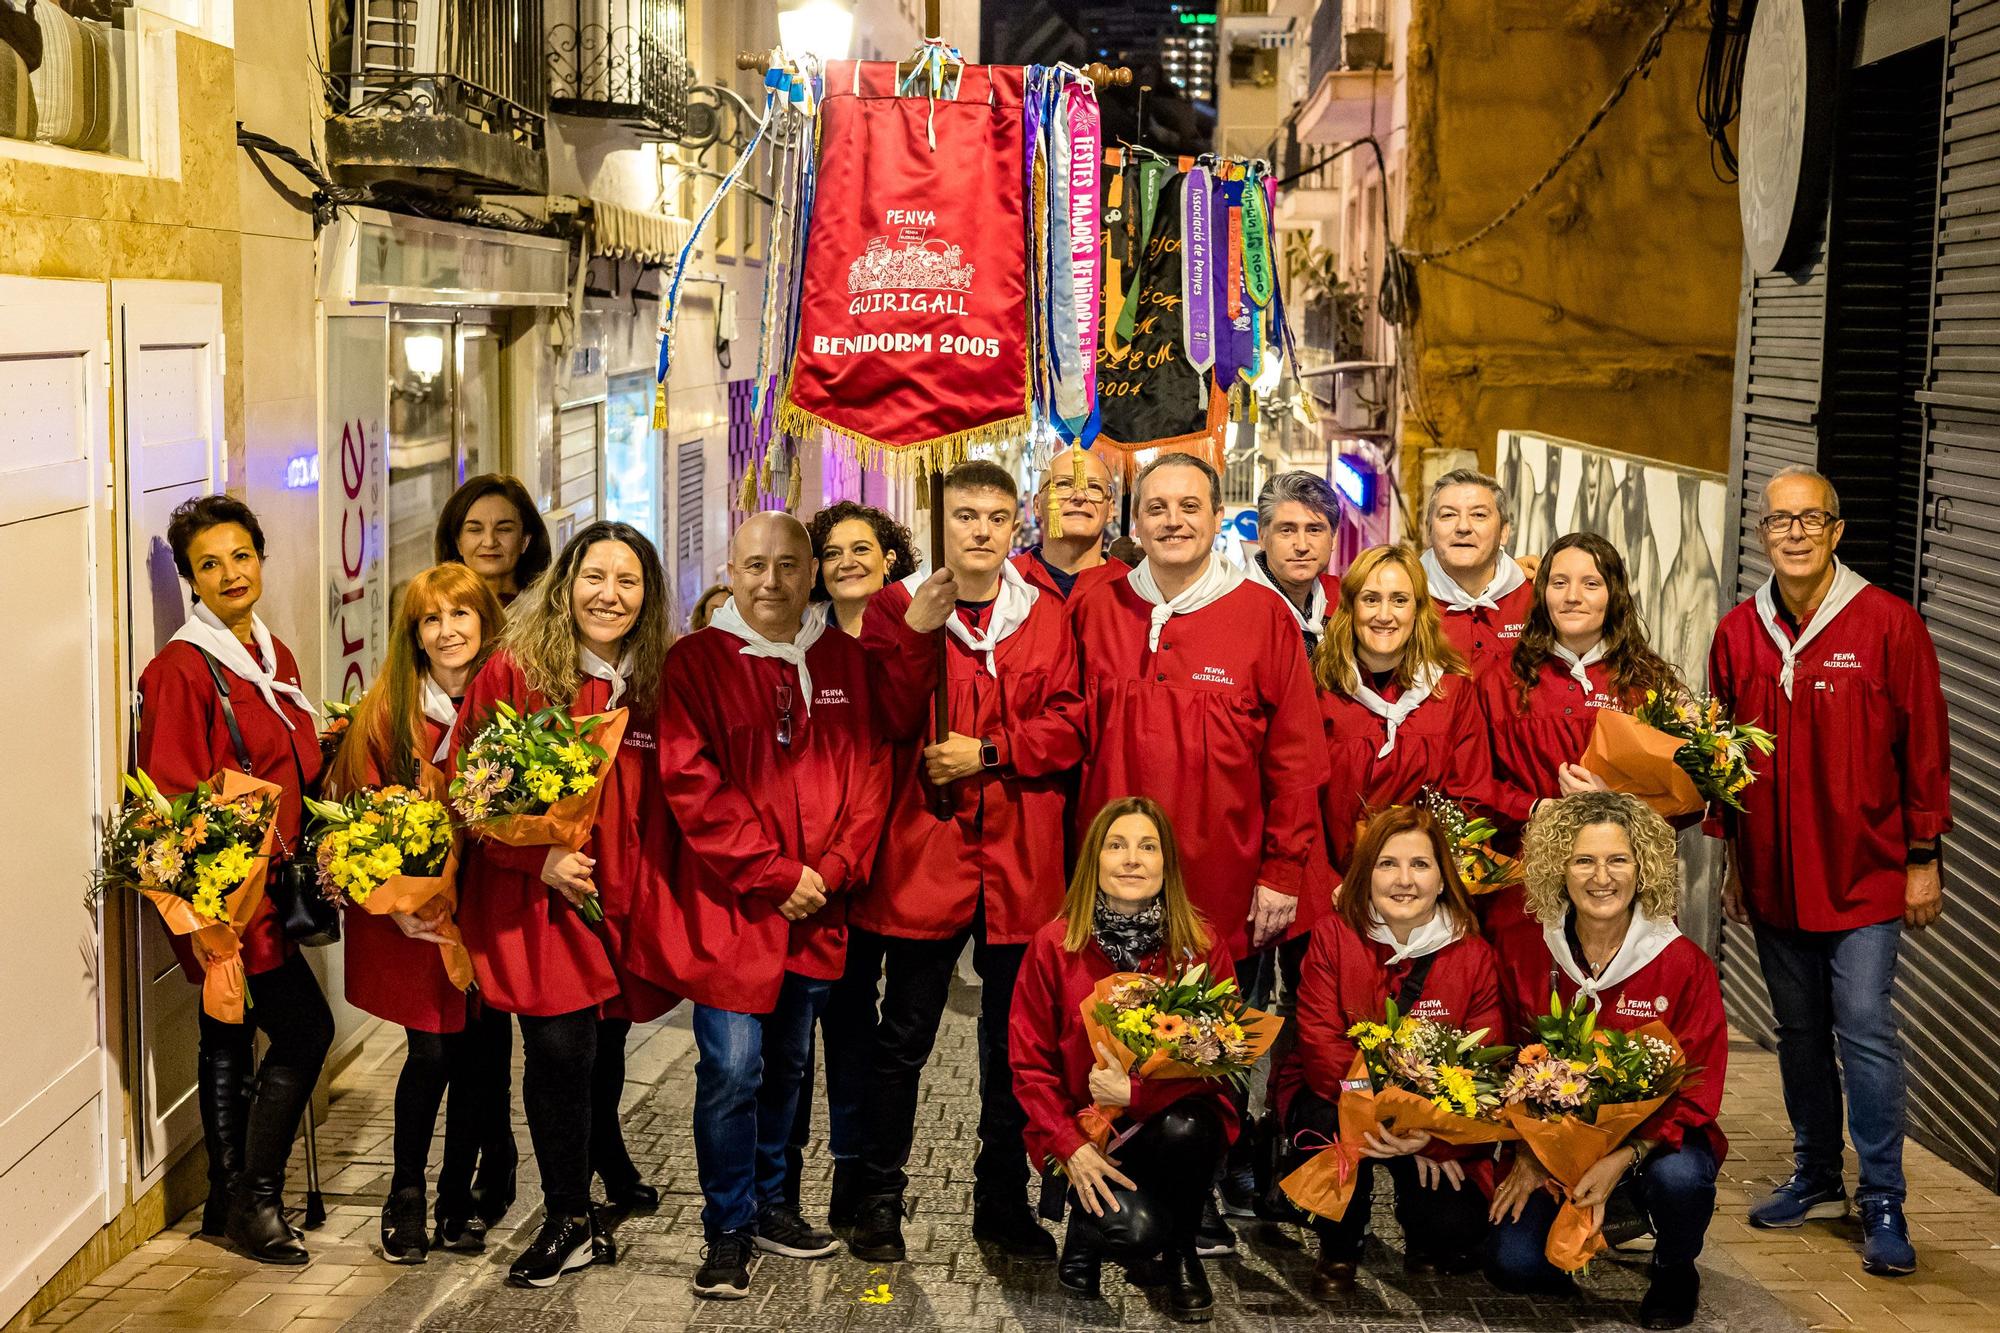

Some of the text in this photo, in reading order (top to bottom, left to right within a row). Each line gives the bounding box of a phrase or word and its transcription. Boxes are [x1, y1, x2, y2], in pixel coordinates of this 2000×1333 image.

[1072, 136, 1095, 188] FESTES
[886, 209, 936, 226] PENYA
[1192, 188, 1206, 241] Associació
[1071, 194, 1094, 254] MAJORS
[1194, 244, 1206, 257] de
[1191, 260, 1205, 296] Penyes
[1252, 254, 1264, 293] 2010
[848, 293, 969, 316] GUIRIGALL
[813, 333, 1000, 358] BENIDORM 2005
[369, 420, 381, 680] omplements
[1833, 652, 1855, 661] PENYA
[1204, 666, 1225, 675] PENYA
[1823, 660, 1862, 668] GUIRIGALL
[1192, 673, 1235, 685] GUIRIGALL
[821, 689, 844, 697] PENYA
[1595, 693, 1618, 704] PENA
[1420, 999, 1442, 1008] PENYA
[1628, 999, 1651, 1009] PENYA
[1616, 1008, 1658, 1018] GUIRIGALL
